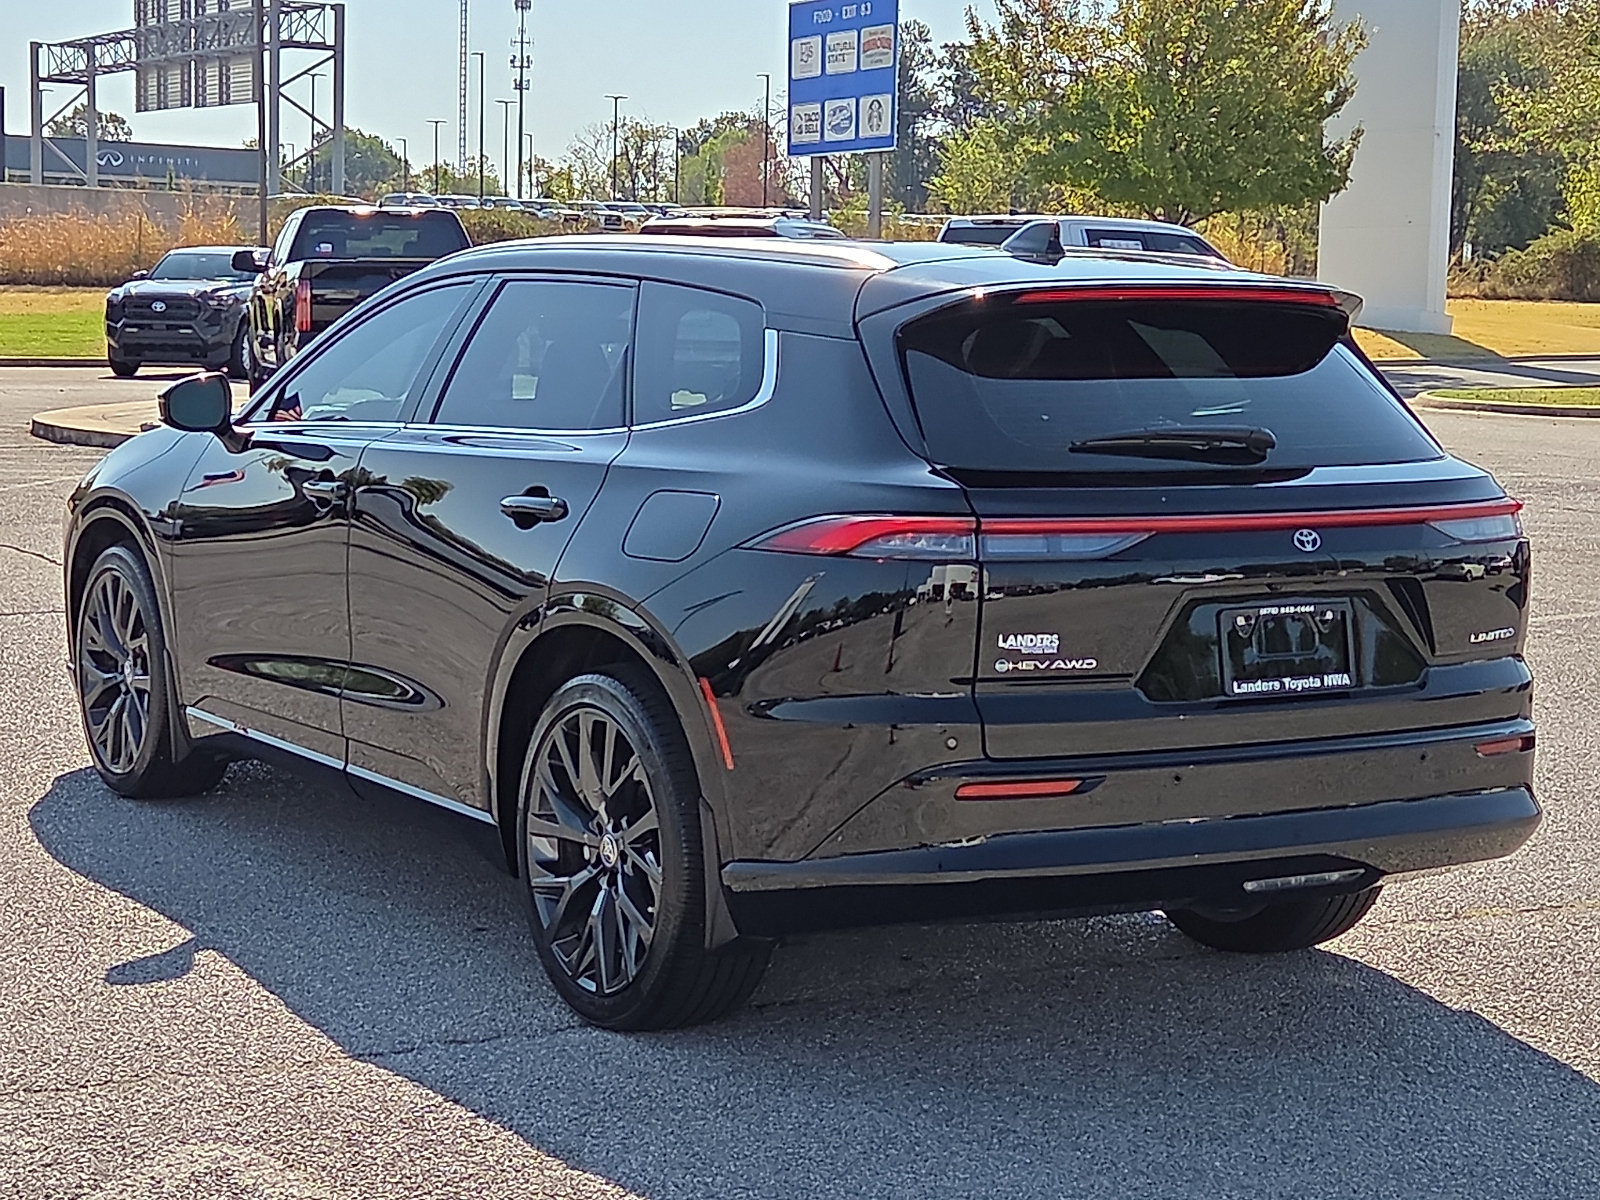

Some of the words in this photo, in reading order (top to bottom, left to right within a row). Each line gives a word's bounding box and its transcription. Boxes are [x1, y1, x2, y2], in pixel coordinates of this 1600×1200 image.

[813, 9, 833, 24] FOOD
[842, 4, 858, 20] EXIT
[804, 111, 820, 122] TACO
[804, 123, 819, 134] BELL
[130, 154, 198, 167] INFINITI
[998, 633, 1059, 649] LANDERS
[1050, 659, 1098, 670] AWD
[1233, 680, 1281, 693] Landers
[1282, 676, 1321, 692] Toyota
[1323, 673, 1351, 687] NWA
